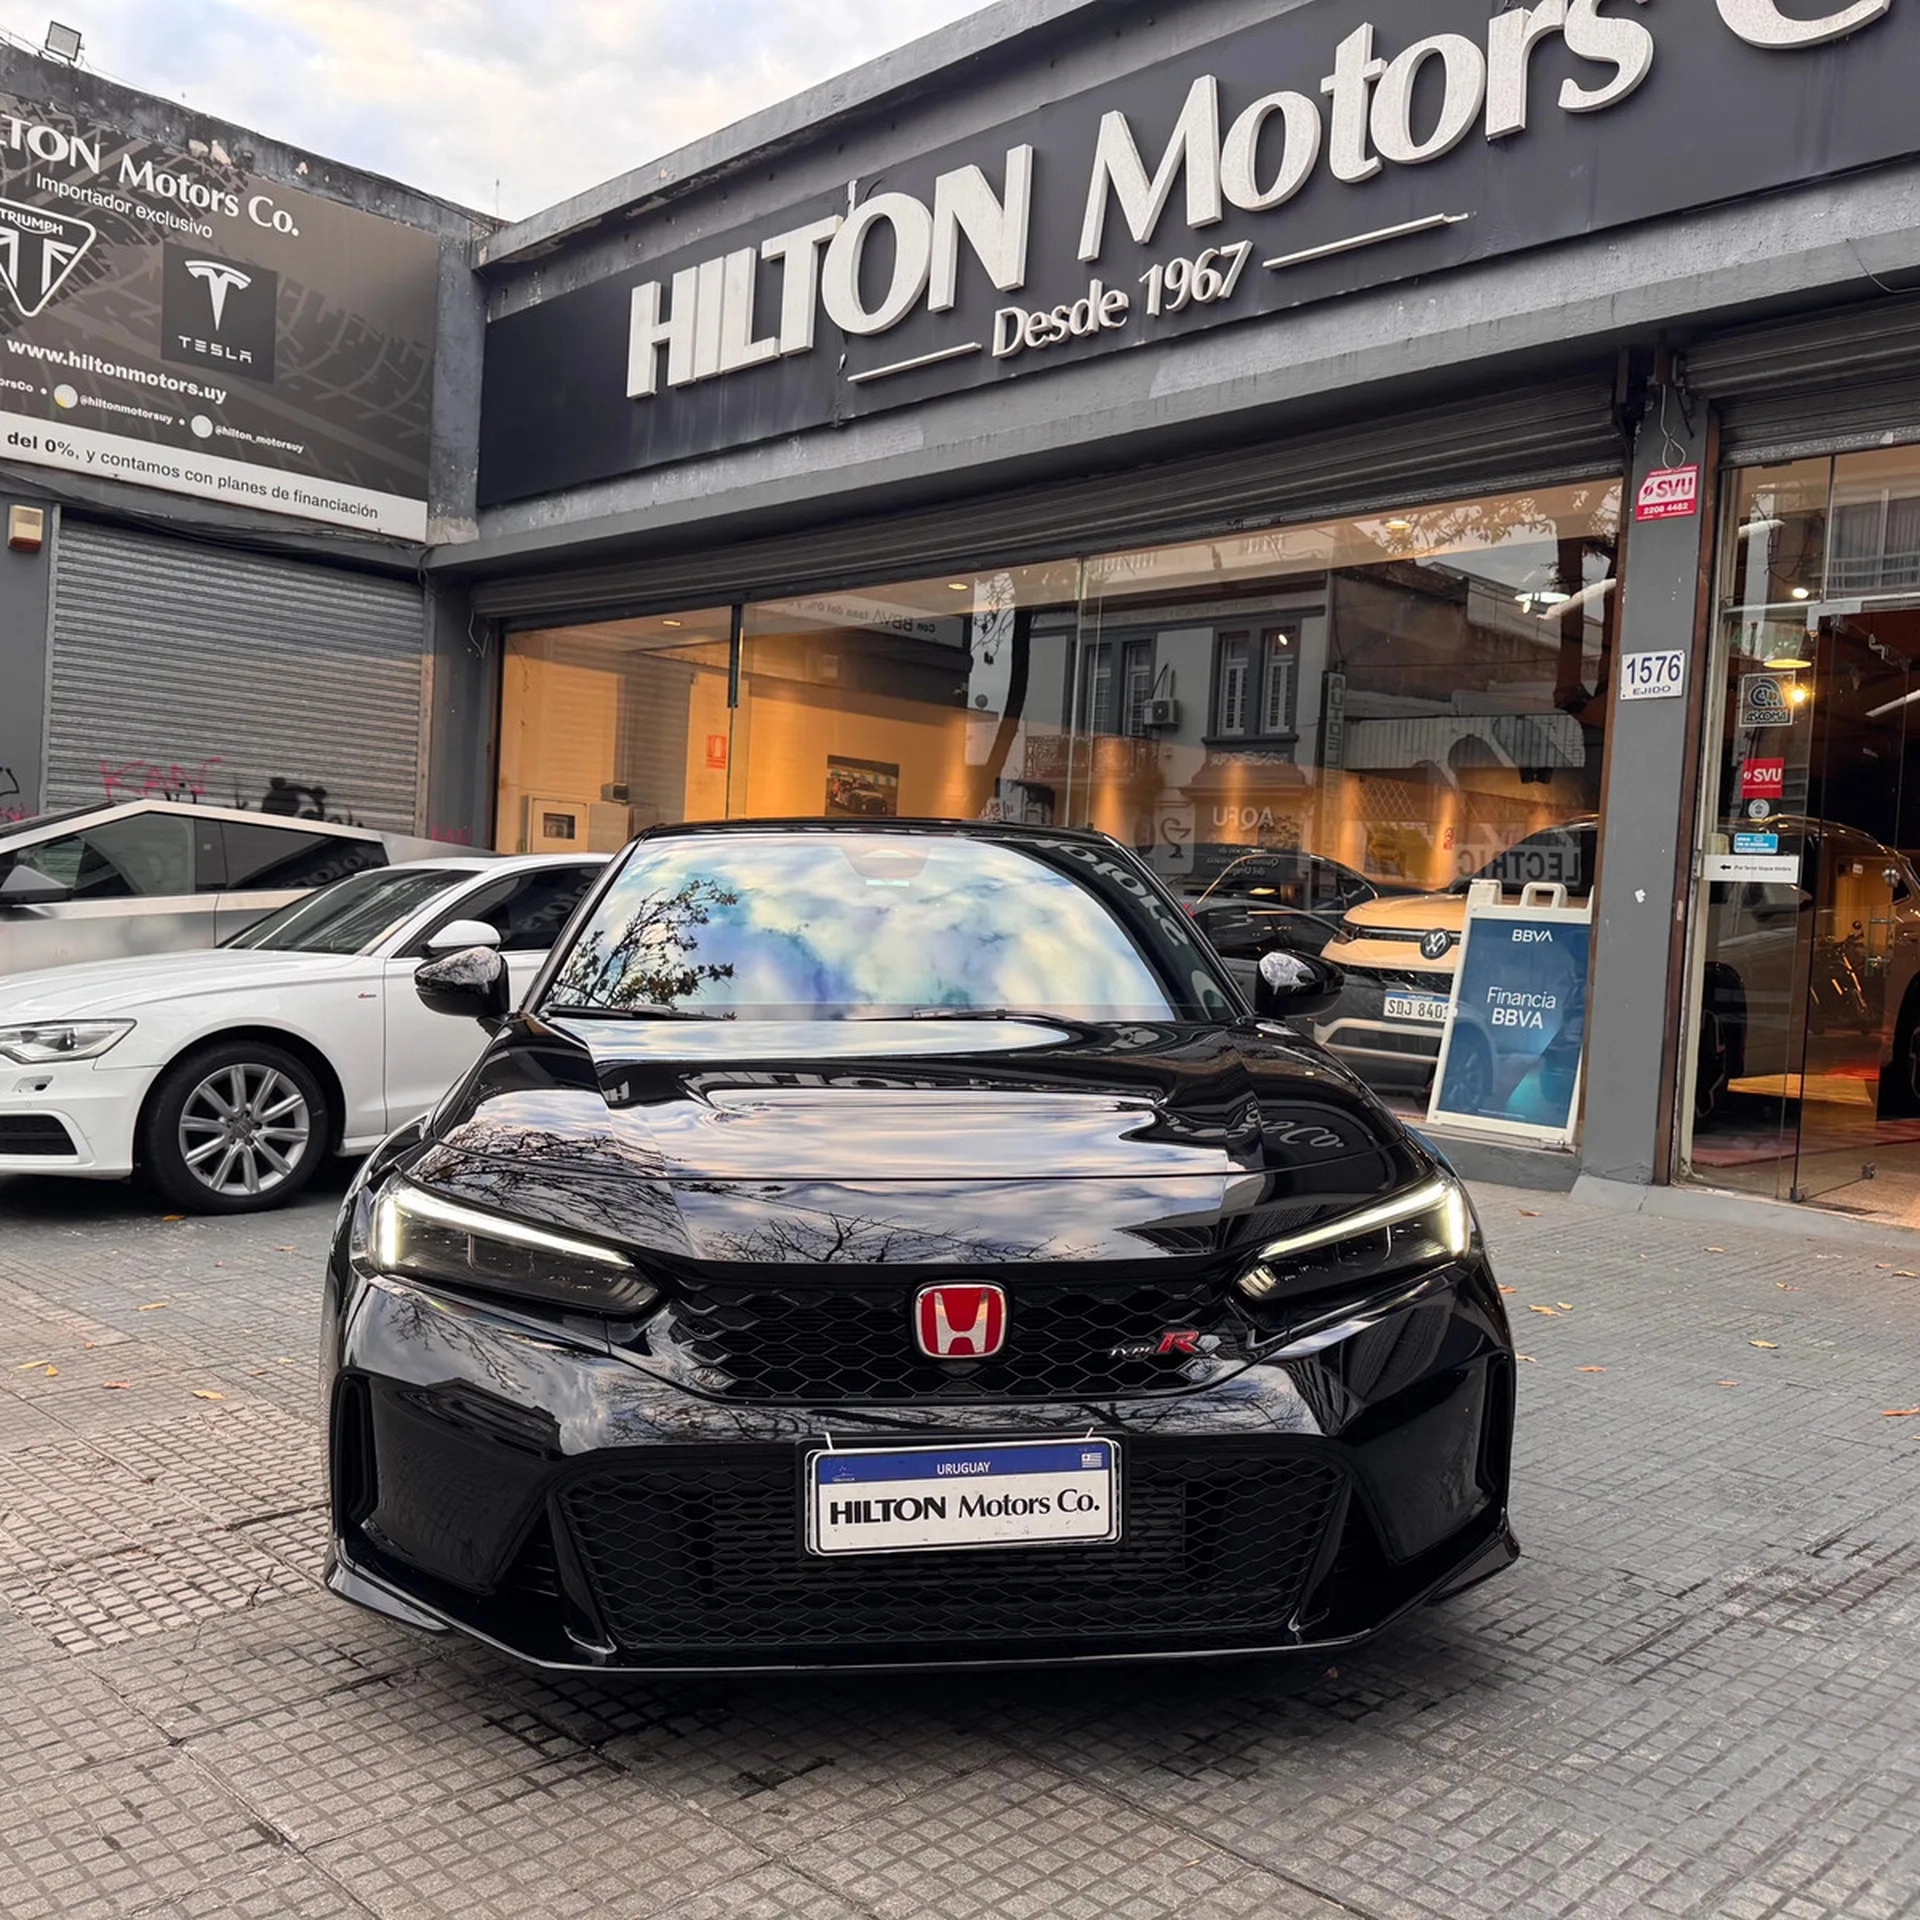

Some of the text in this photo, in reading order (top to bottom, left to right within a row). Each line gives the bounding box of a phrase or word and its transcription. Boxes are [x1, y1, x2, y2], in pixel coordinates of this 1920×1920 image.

[0, 112, 299, 237] TON Motors Co.
[36, 172, 213, 239] Importador exclusivo
[627, 0, 1655, 399] HILTON Motors
[0, 207, 63, 236] TRIUMPH
[992, 240, 1254, 358] Desde 1967
[178, 335, 252, 364] TESLA
[7, 339, 228, 405] www.hiltonmotors.uy
[80, 394, 174, 425] @hiltonmotorsuy
[7, 431, 379, 519] del 0%, y contamos con planes de financiación
[1656, 477, 1693, 498] SVU
[1626, 654, 1681, 685] 1576
[1632, 685, 1671, 696] EJIDO
[1753, 767, 1782, 782] SVU
[1511, 929, 1553, 943] BBVA
[1387, 999, 1449, 1020] SDJ 840
[1486, 986, 1557, 1010] Financia
[1491, 1006, 1544, 1030] BBVA
[1156, 1330, 1200, 1354] R
[936, 1460, 991, 1475] URUGUAY
[829, 1488, 1101, 1526] HILTON Motors Co.
